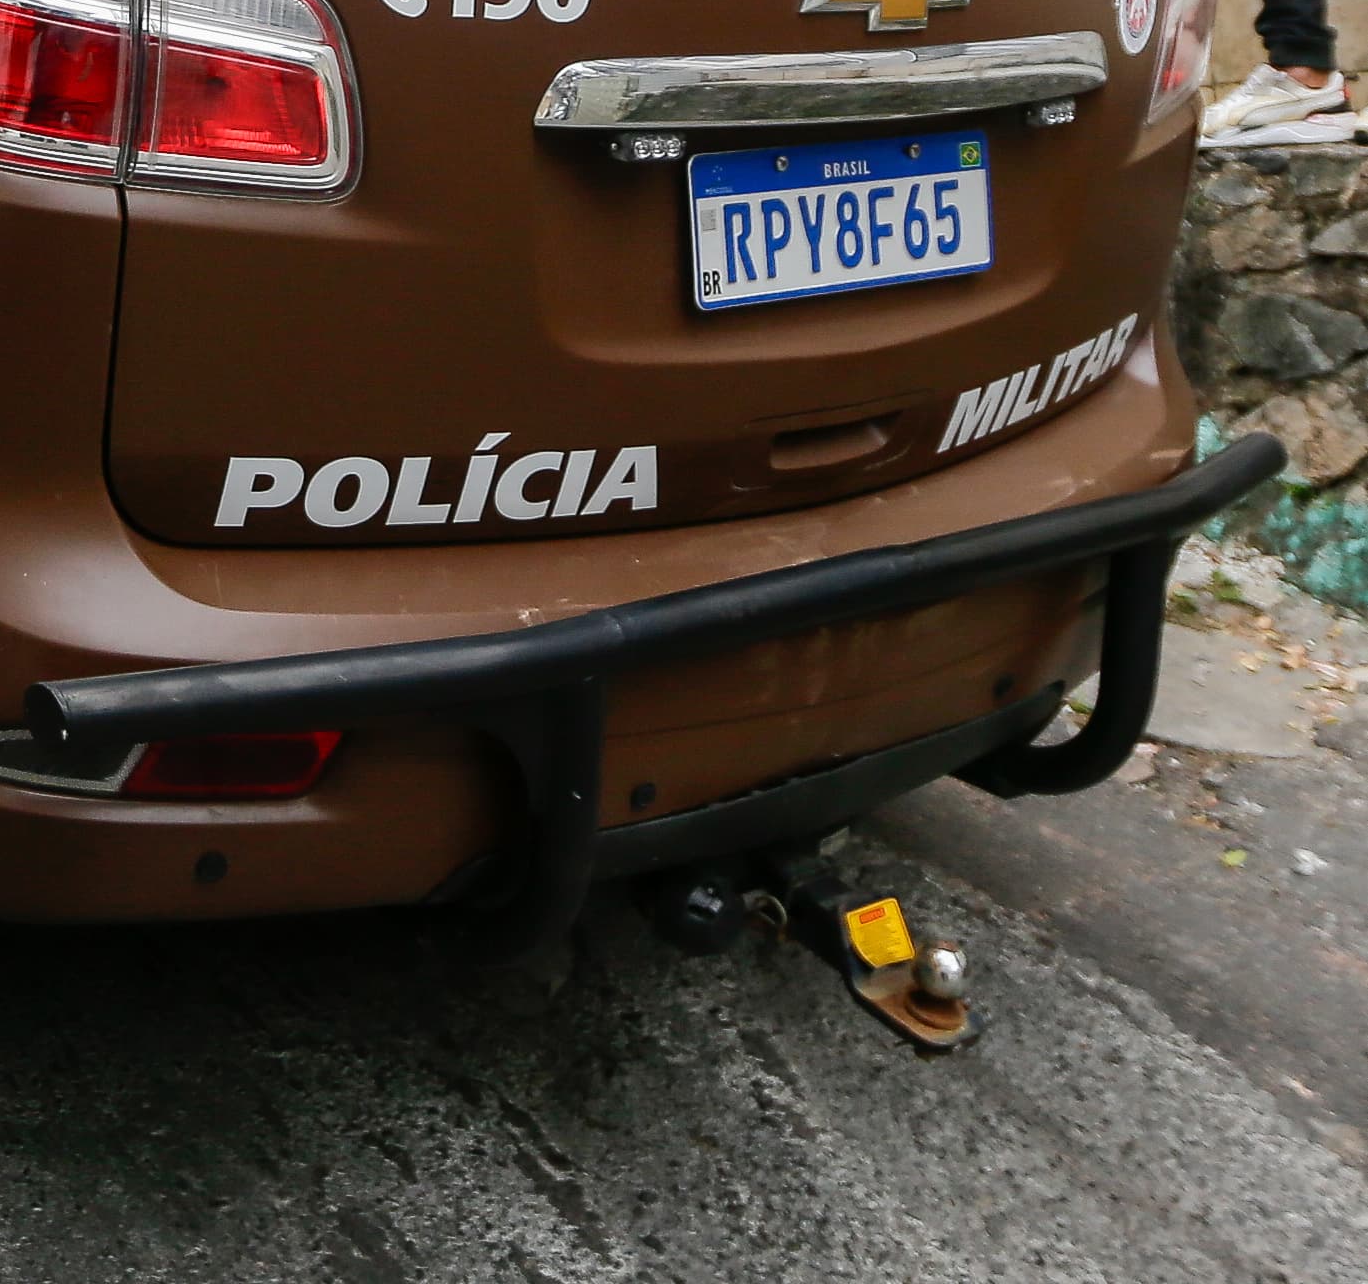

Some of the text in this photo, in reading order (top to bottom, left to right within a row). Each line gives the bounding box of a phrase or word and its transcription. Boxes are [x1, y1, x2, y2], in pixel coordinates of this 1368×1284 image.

[823, 160, 871, 179] BRASIL
[723, 179, 961, 284] RPY8F65
[702, 270, 722, 297] BR
[214, 313, 1139, 528] POLÍCIA MILITAR
